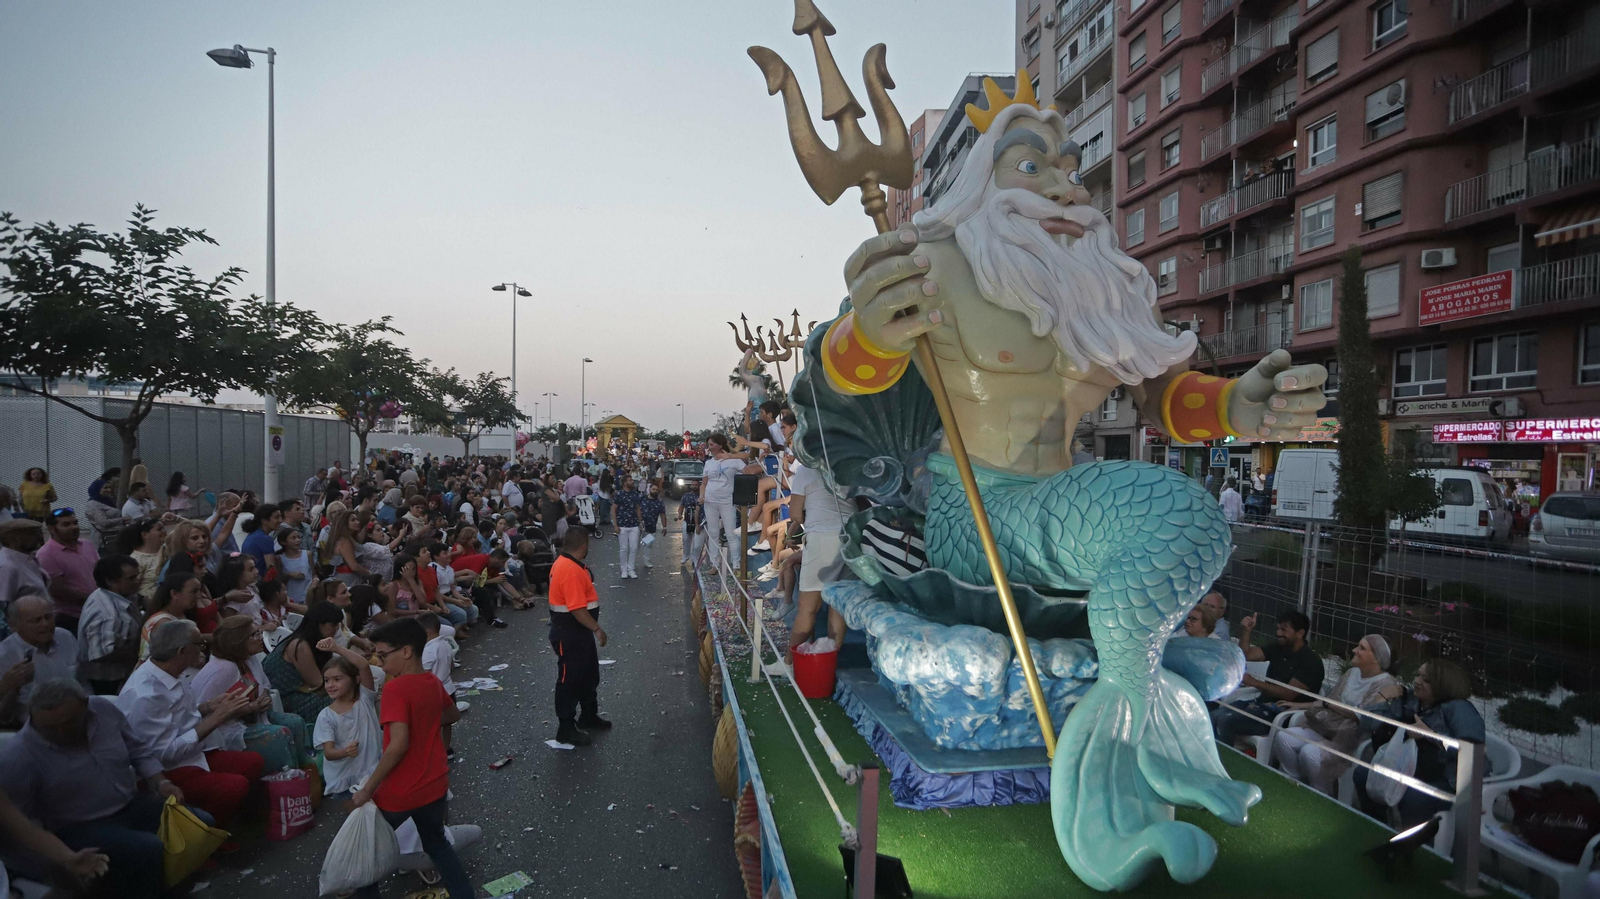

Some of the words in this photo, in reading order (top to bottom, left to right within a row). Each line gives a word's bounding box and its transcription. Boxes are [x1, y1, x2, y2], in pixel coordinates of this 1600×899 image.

[1424, 289, 1442, 297] JOSE
[1443, 282, 1471, 293] PORRAS
[1472, 274, 1506, 286] PEDRAZA
[1454, 289, 1476, 299] MARIA
[1478, 284, 1502, 294] MARIN
[1430, 292, 1499, 312] ABOGADOS
[1411, 401, 1448, 411] Moriche
[1433, 422, 1502, 433] SUPERMERCADO
[1457, 432, 1493, 441] Estrellas
